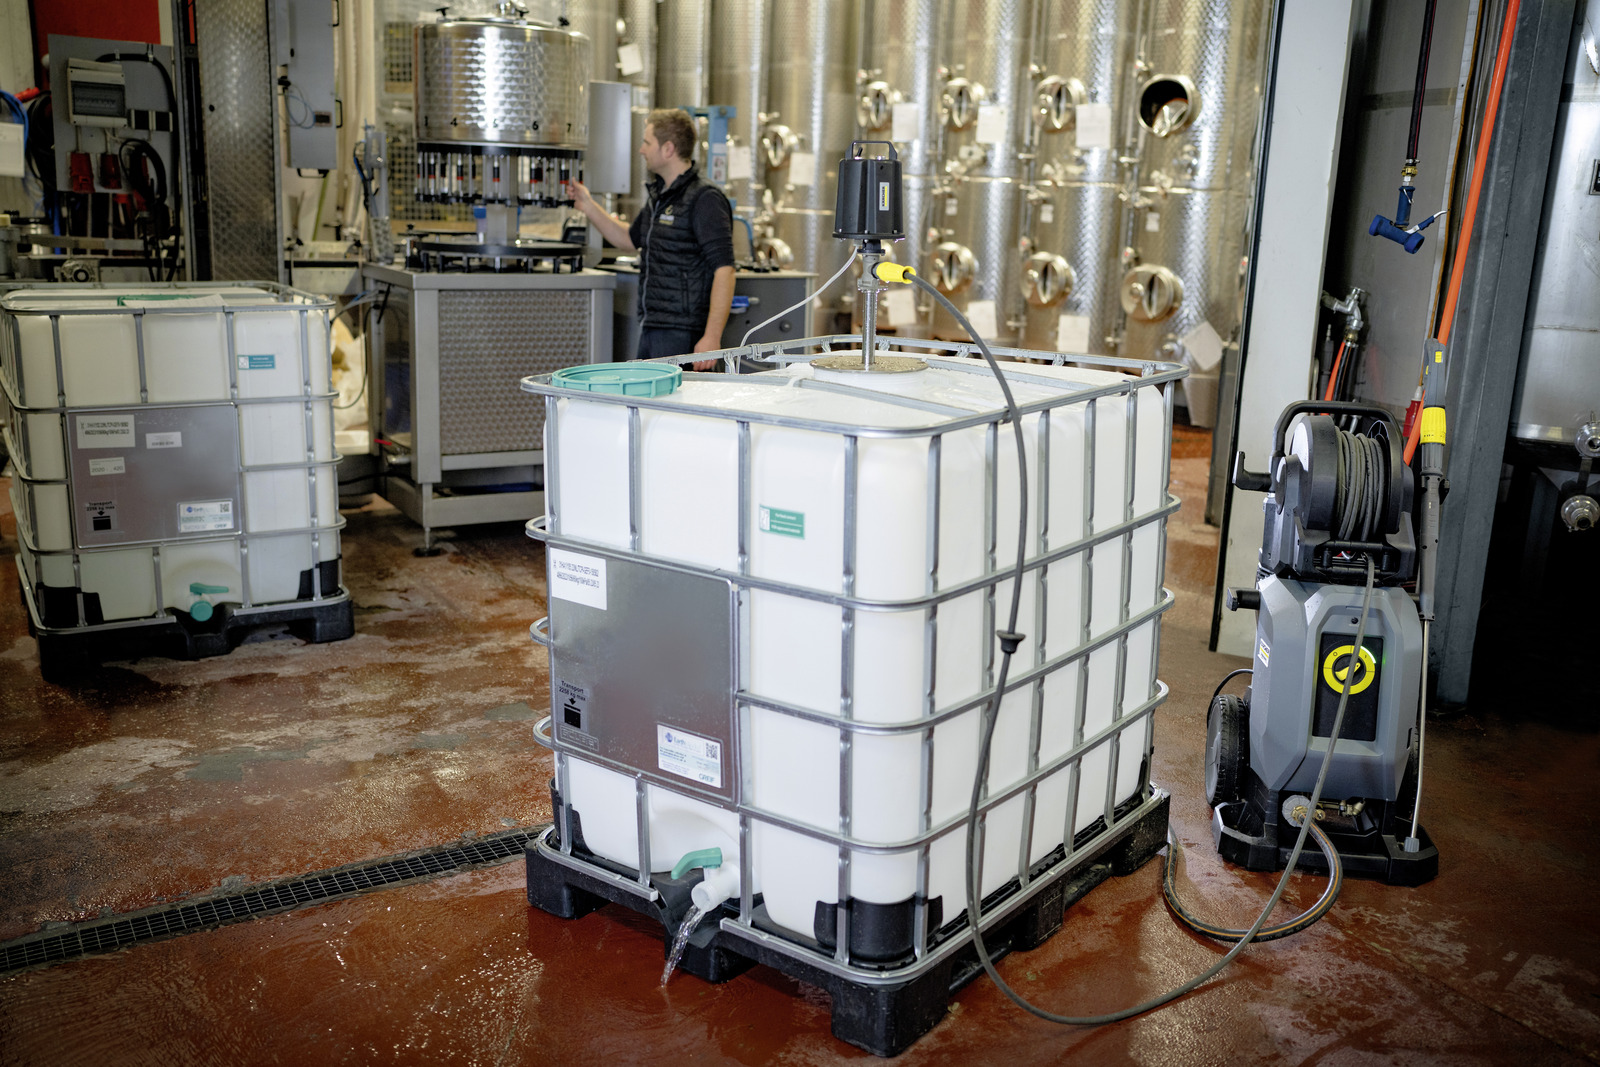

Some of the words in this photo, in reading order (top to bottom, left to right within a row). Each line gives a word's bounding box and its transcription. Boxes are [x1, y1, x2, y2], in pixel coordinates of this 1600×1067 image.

[450, 117, 458, 127] 4
[492, 118, 498, 128] 5
[532, 120, 539, 131] 6
[567, 123, 572, 133] 7
[561, 680, 584, 694] Transport
